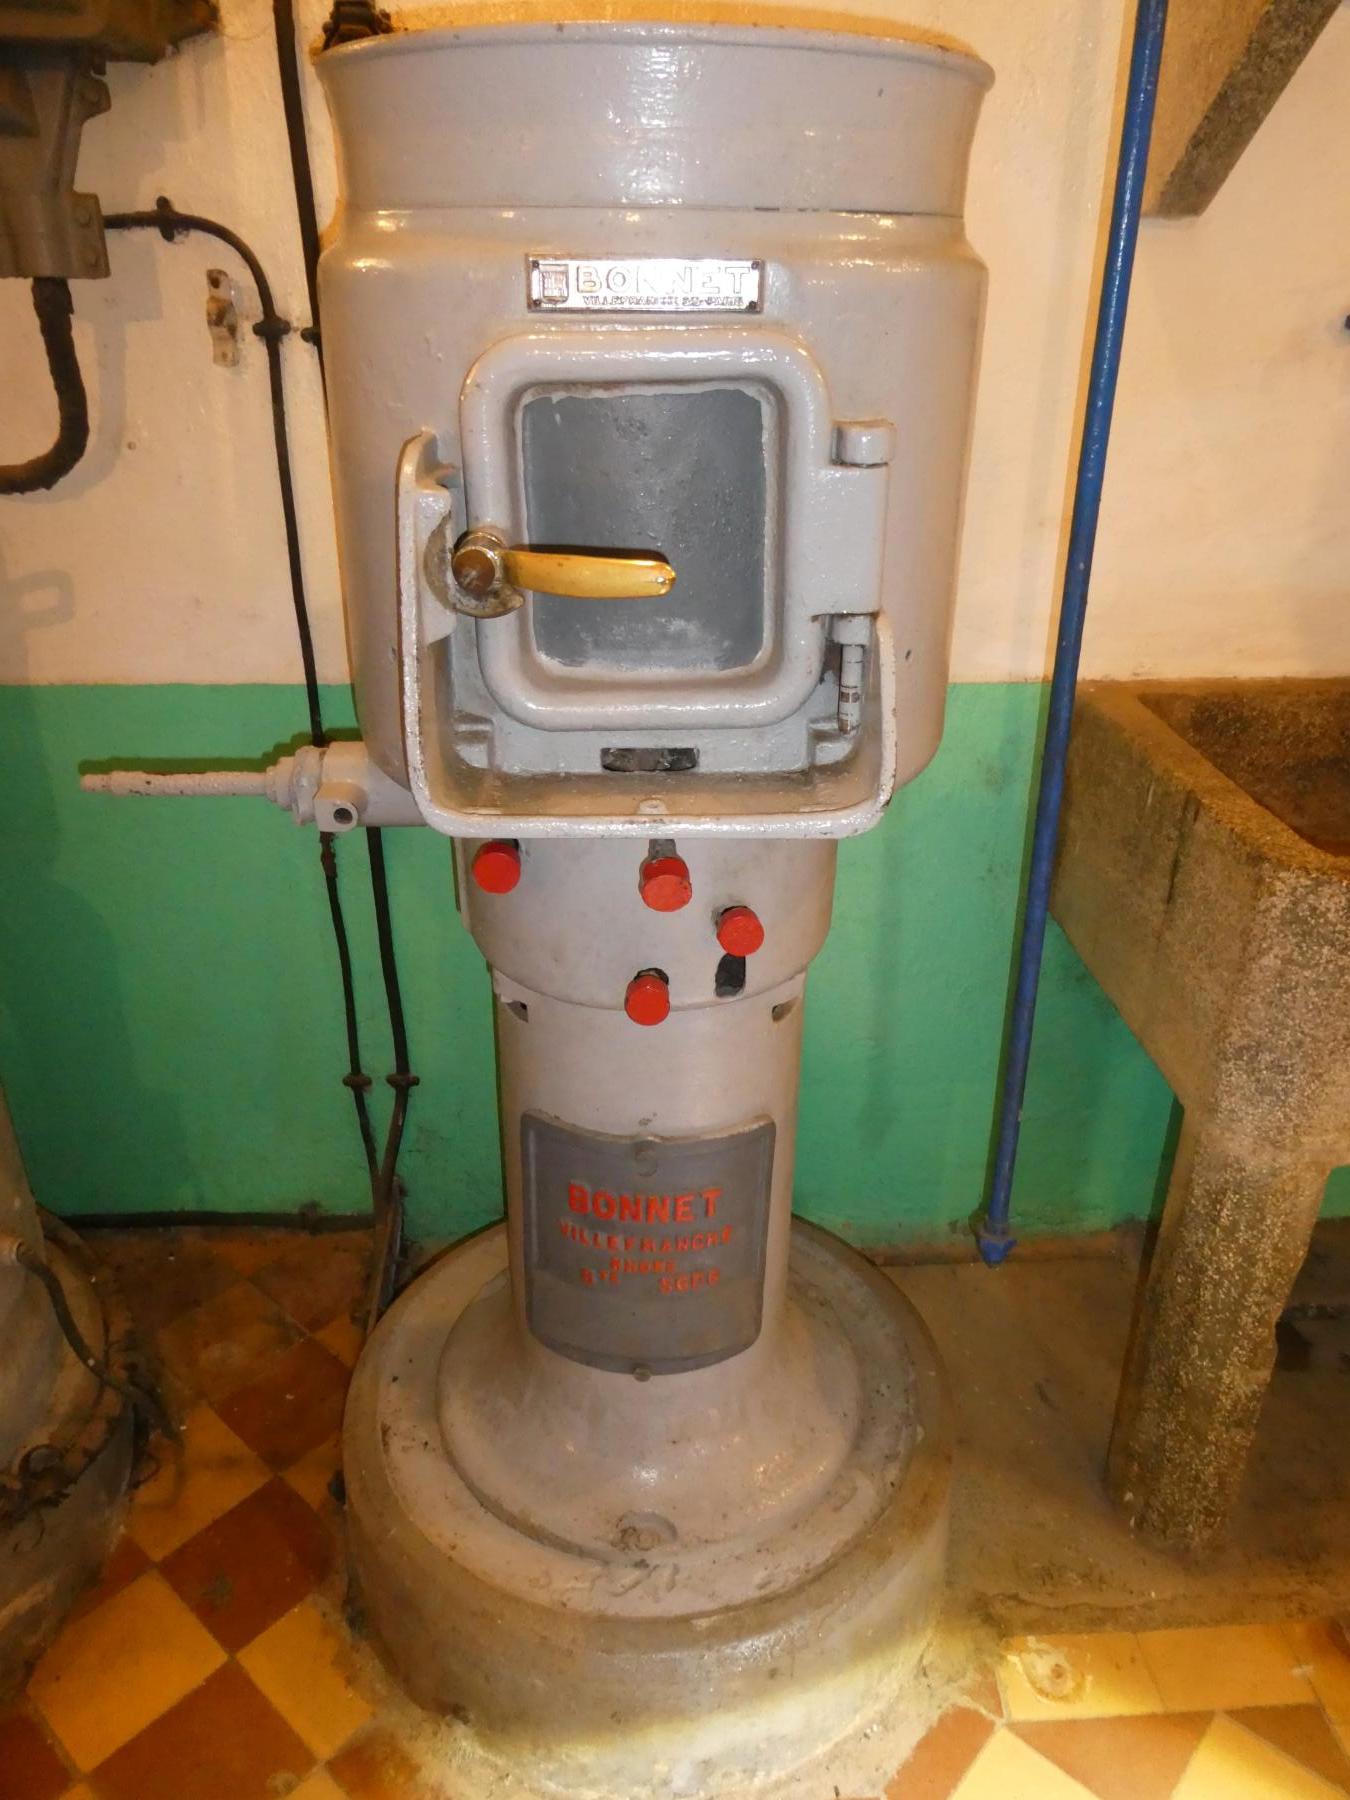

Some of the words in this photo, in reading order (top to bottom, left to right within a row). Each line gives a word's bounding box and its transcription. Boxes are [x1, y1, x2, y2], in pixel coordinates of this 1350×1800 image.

[577, 265, 750, 294] BONNET
[568, 1183, 722, 1224] BONNET
[560, 1221, 733, 1252] VILLEFRANCHE
